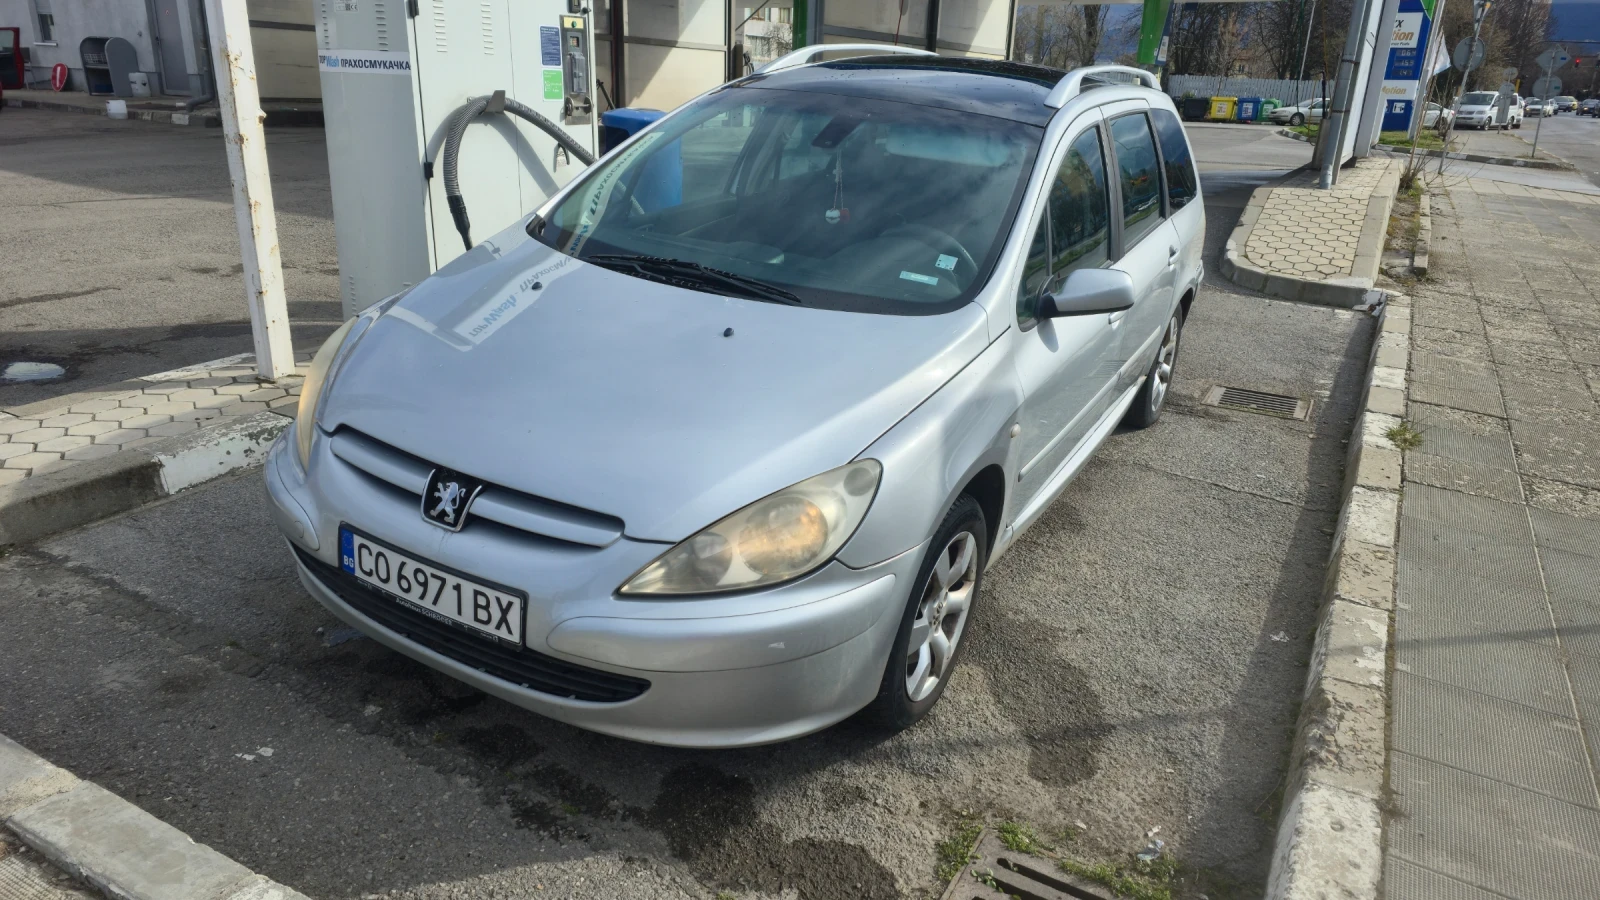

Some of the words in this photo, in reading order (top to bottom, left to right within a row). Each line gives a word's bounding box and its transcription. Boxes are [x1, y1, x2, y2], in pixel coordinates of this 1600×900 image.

[341, 58, 411, 71] ПРАХОСМУКАЧКА
[343, 554, 354, 568] BG
[396, 560, 462, 616] 6971
